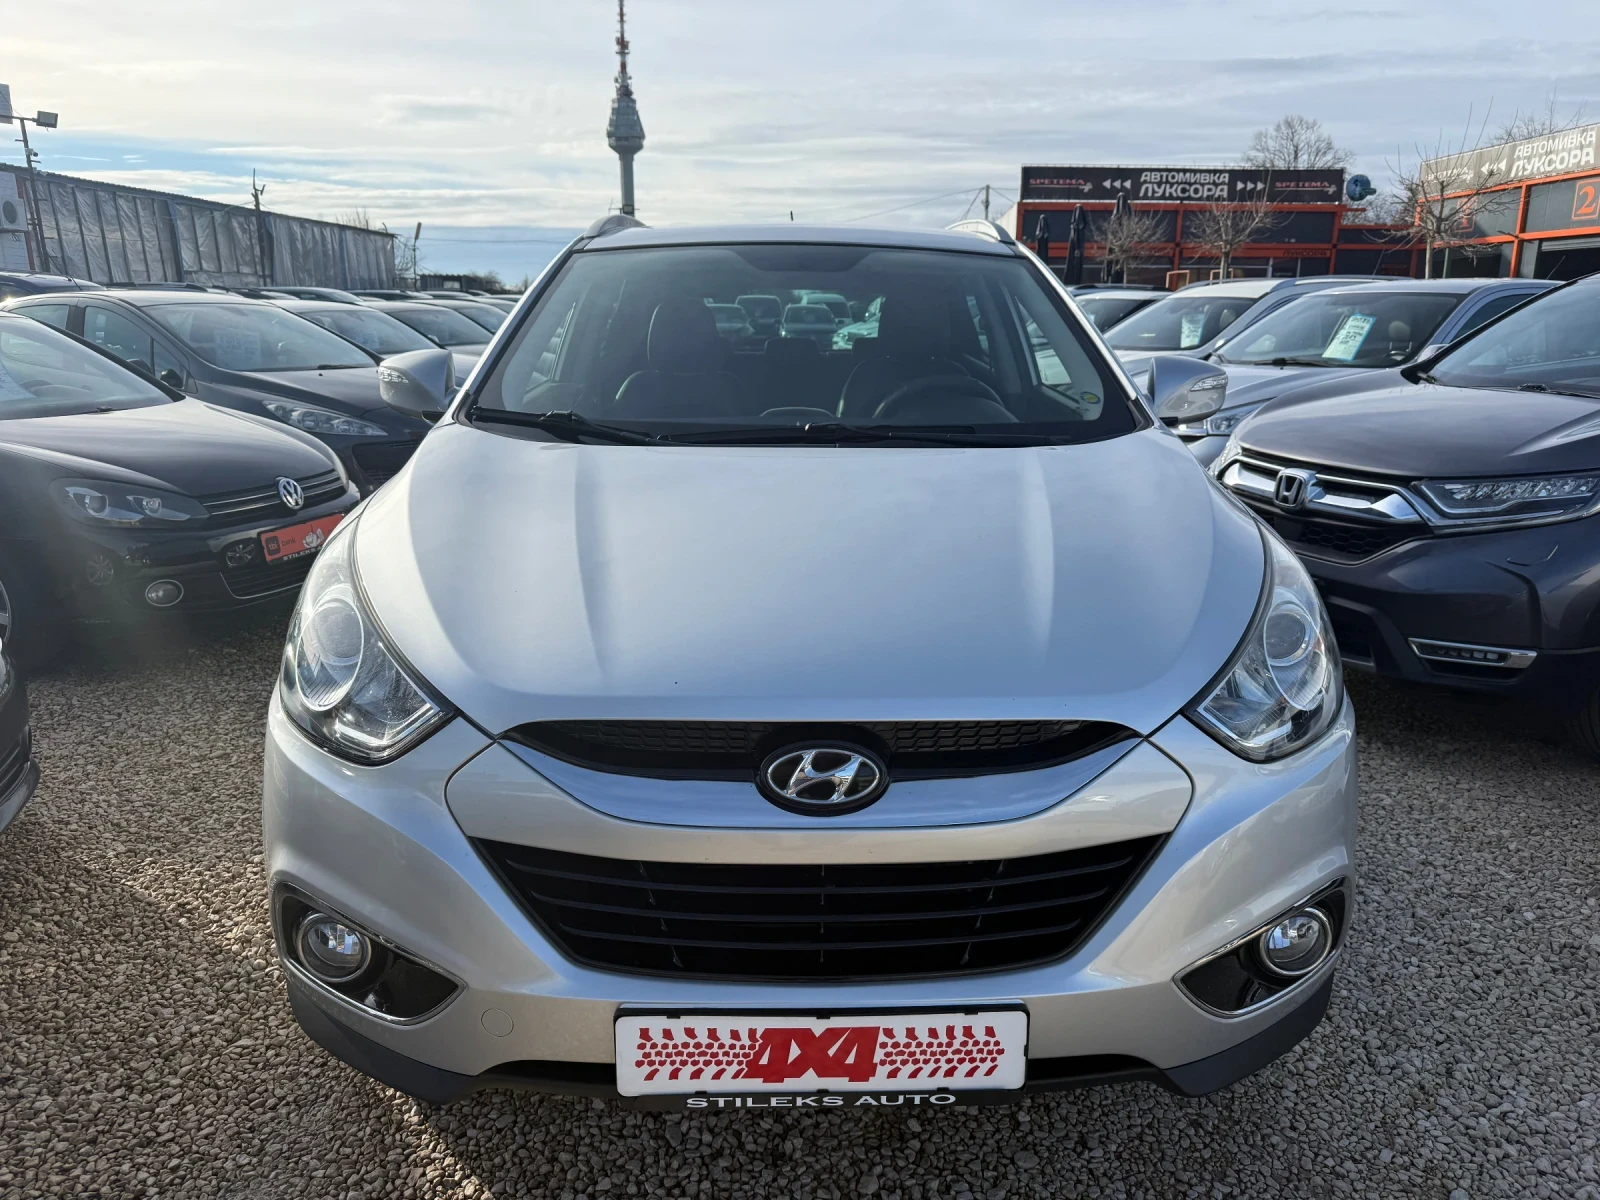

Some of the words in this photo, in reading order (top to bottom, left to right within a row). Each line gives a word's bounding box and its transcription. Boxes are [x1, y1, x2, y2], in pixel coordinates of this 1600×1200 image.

[1514, 131, 1596, 159] АВТОМИВКА
[1510, 148, 1595, 178] ЛУКСОРА
[1140, 171, 1229, 184] АВТОМИВКА
[1139, 183, 1229, 198] ЛУКСОРА
[1576, 185, 1596, 214] 2
[283, 548, 316, 561] STILEKS
[686, 1096, 844, 1108] STILEKS
[853, 1094, 957, 1106] AUTO
